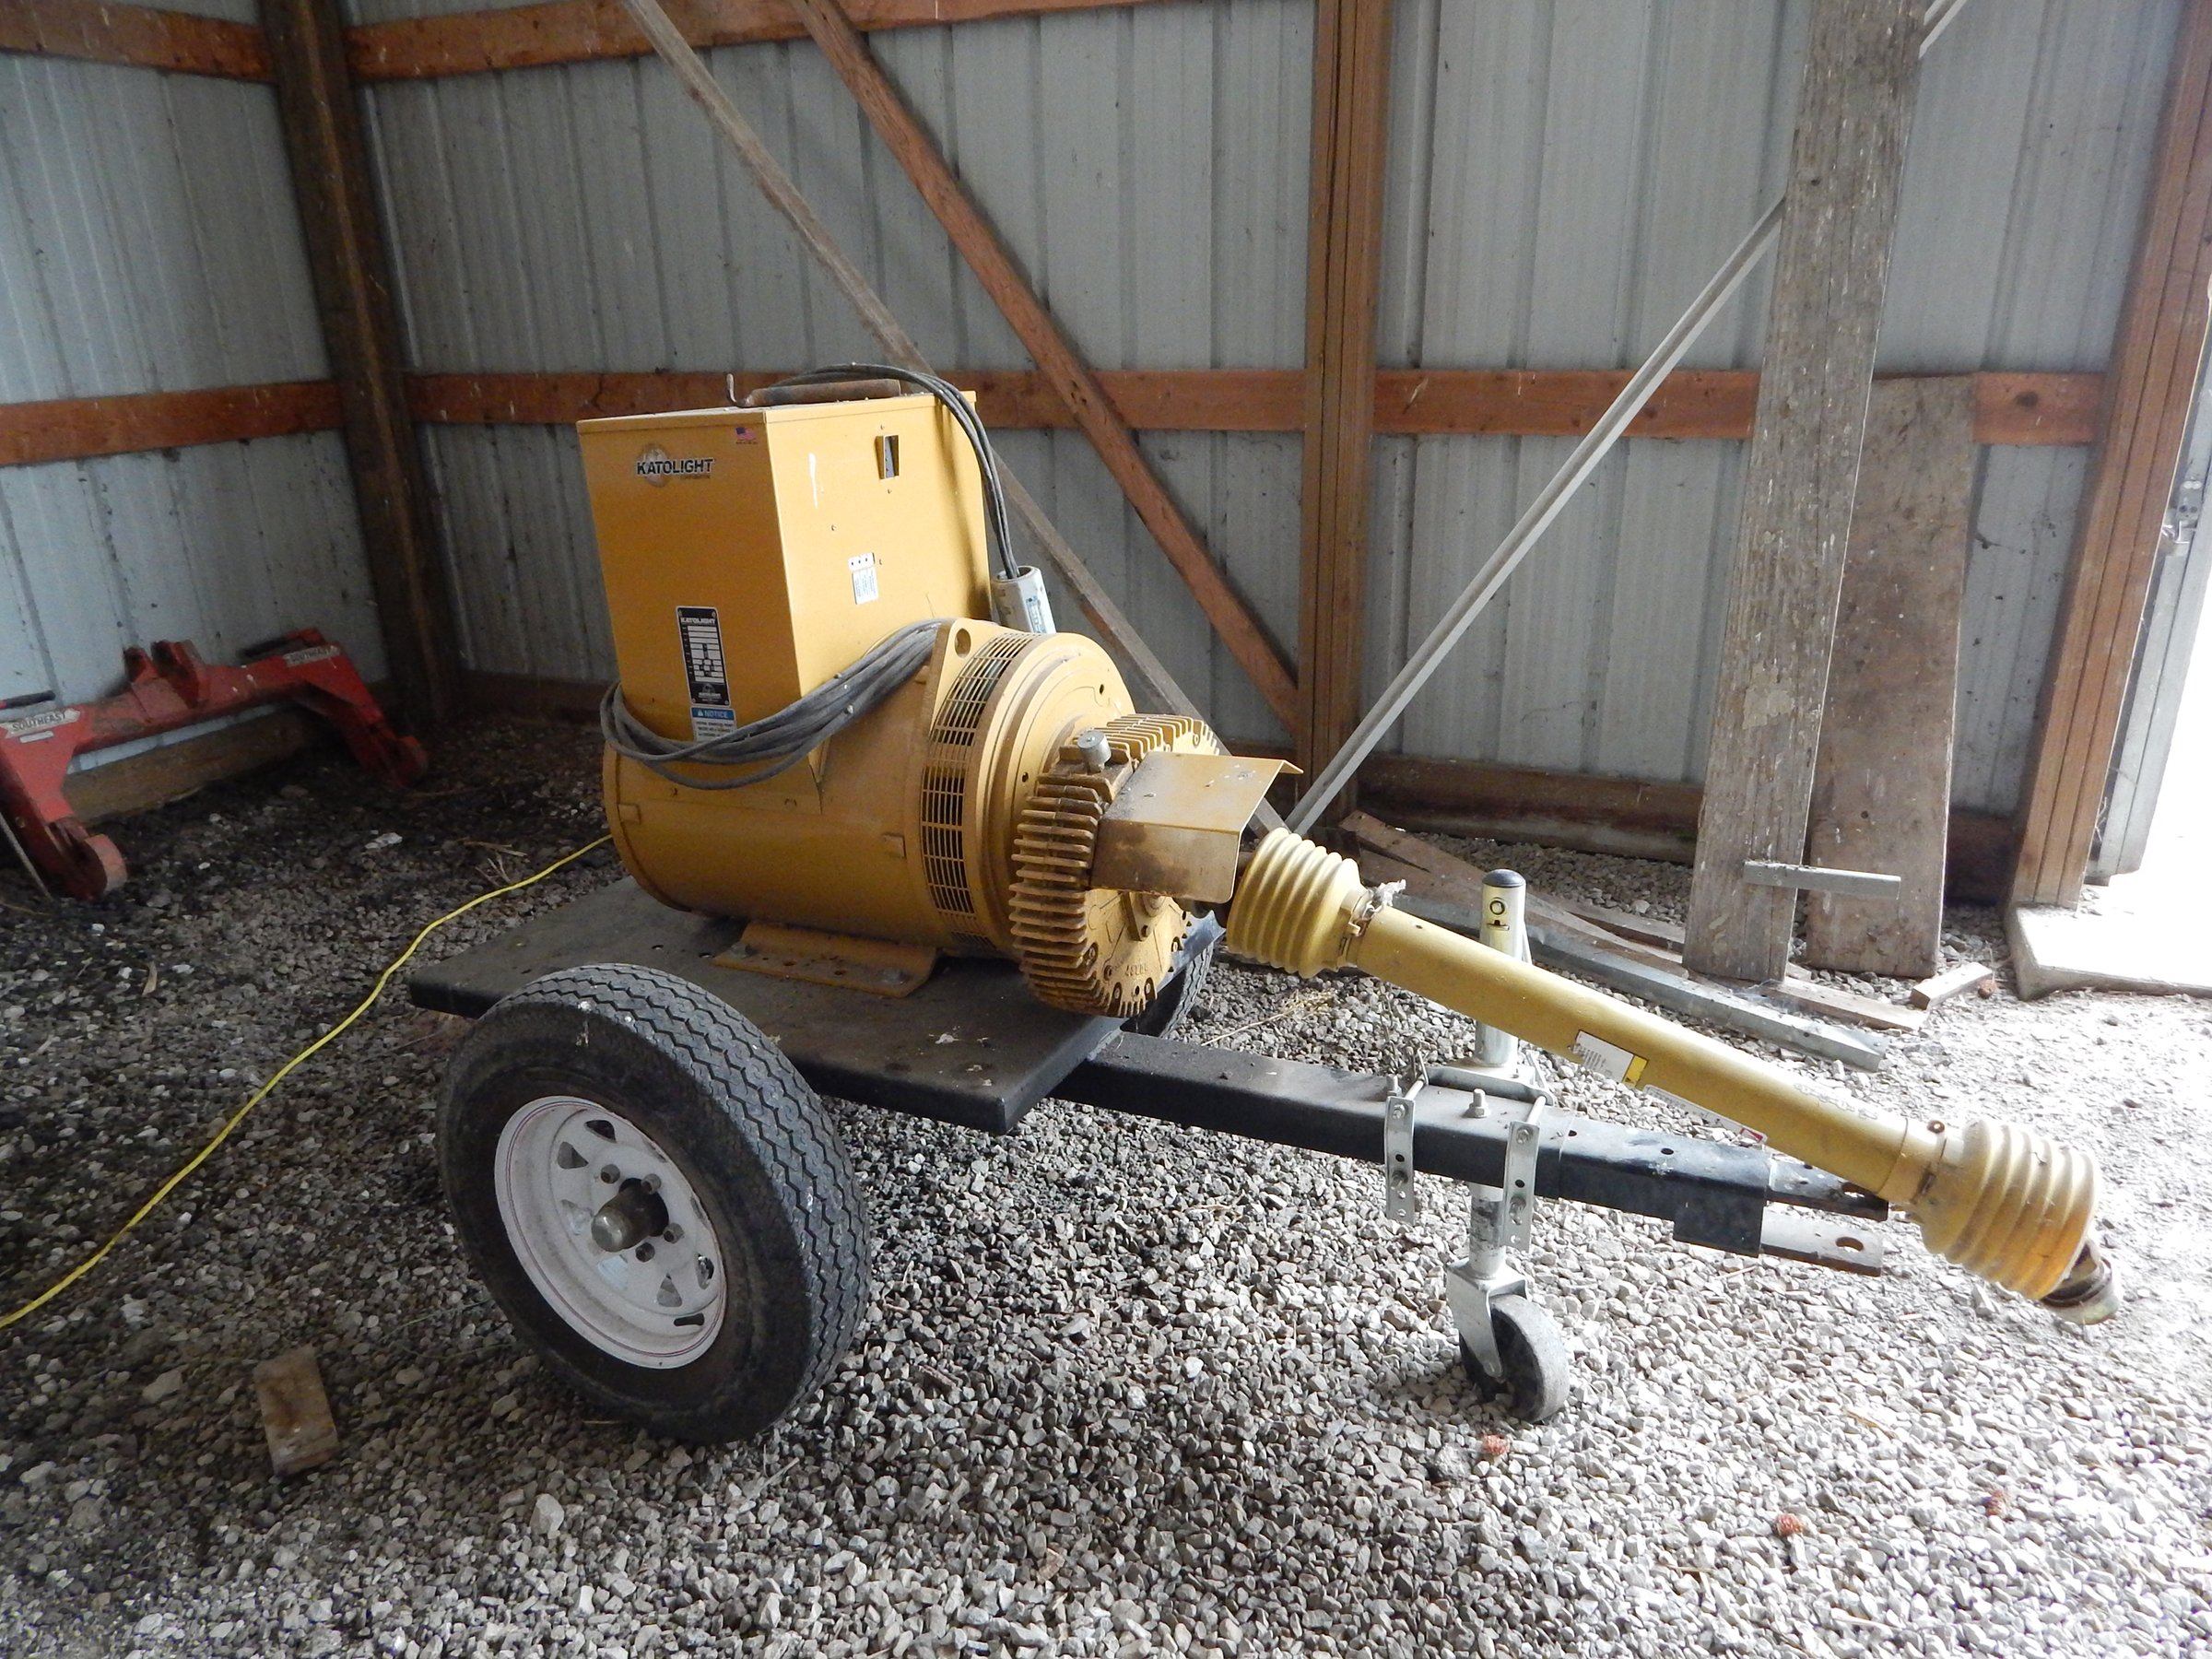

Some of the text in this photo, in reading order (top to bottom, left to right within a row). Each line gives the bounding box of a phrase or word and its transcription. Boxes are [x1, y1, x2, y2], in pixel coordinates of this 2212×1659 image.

[637, 459, 713, 475] KATOLIGHT
[12, 711, 65, 731] SOUTHEAST
[704, 710, 728, 718] NOTICE
